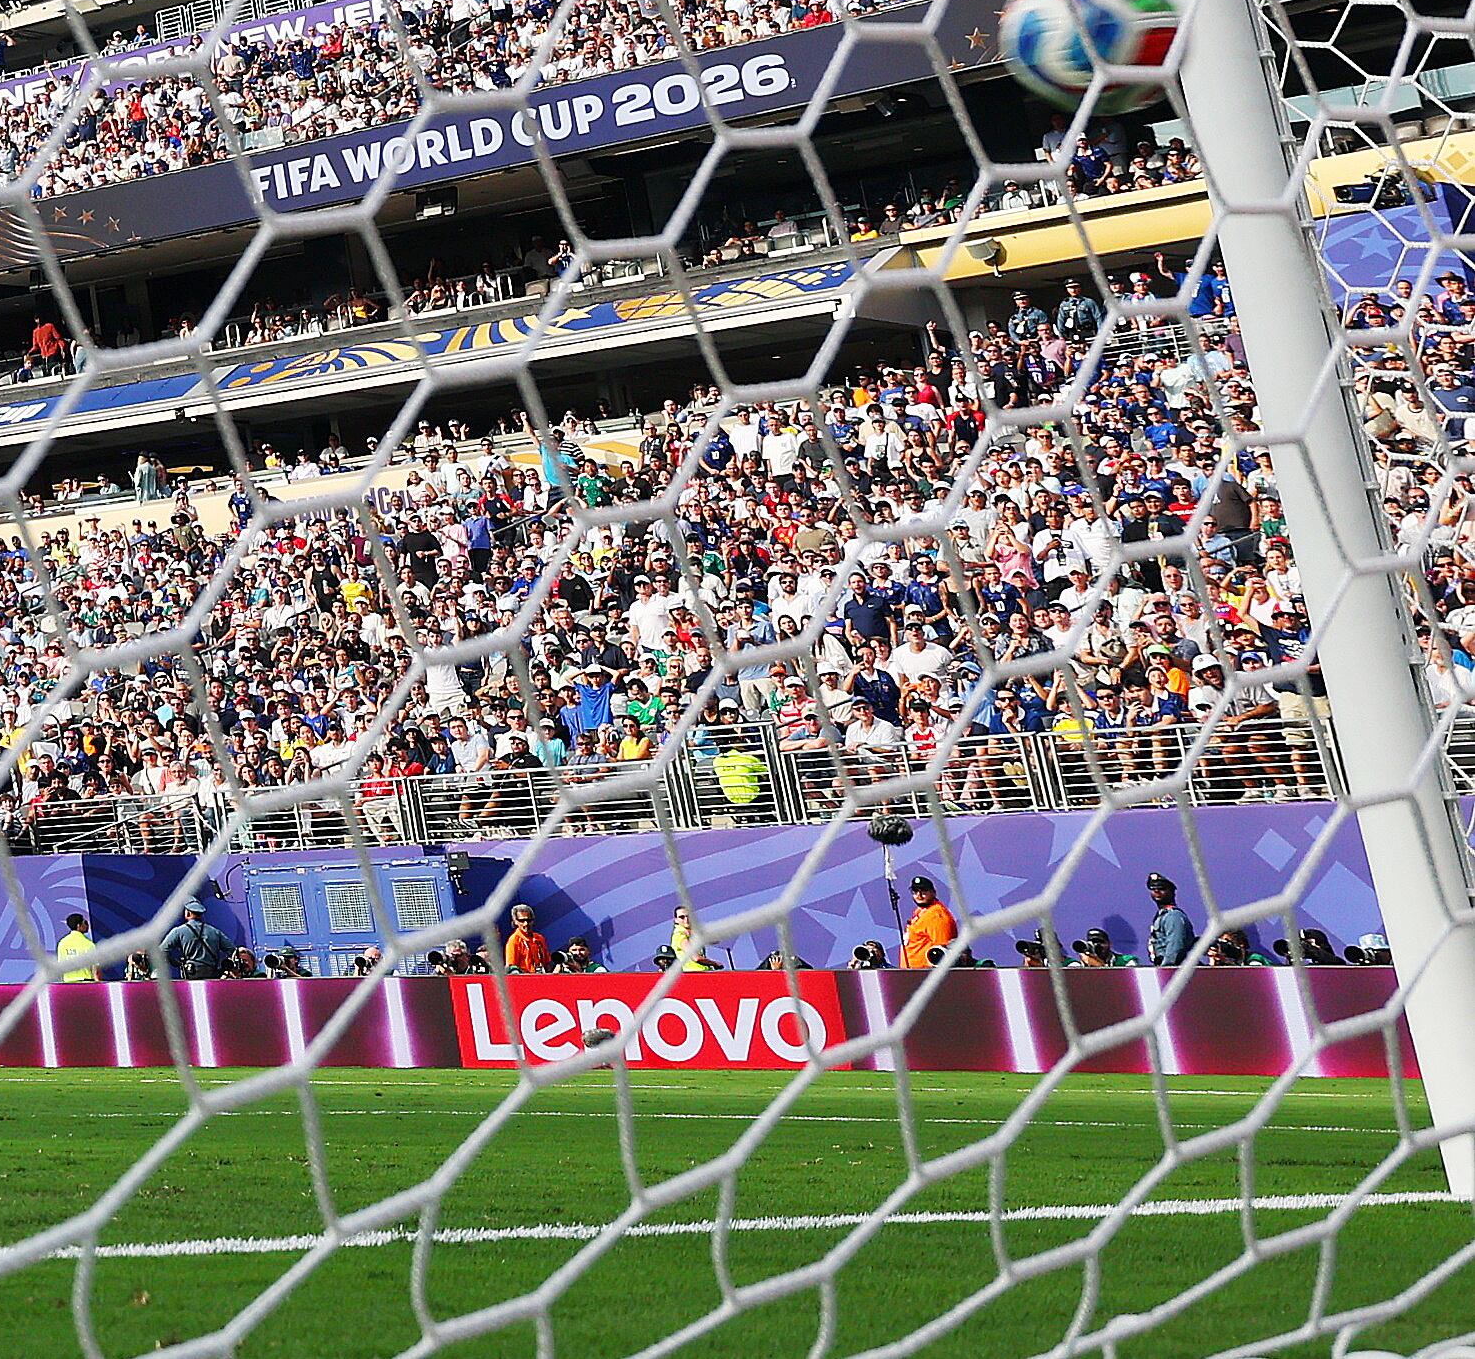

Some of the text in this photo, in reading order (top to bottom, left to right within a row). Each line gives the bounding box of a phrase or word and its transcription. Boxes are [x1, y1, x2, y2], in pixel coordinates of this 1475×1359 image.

[250, 53, 791, 203] FIFA WORLD CUP 2026
[466, 983, 827, 1063] Lenovo
